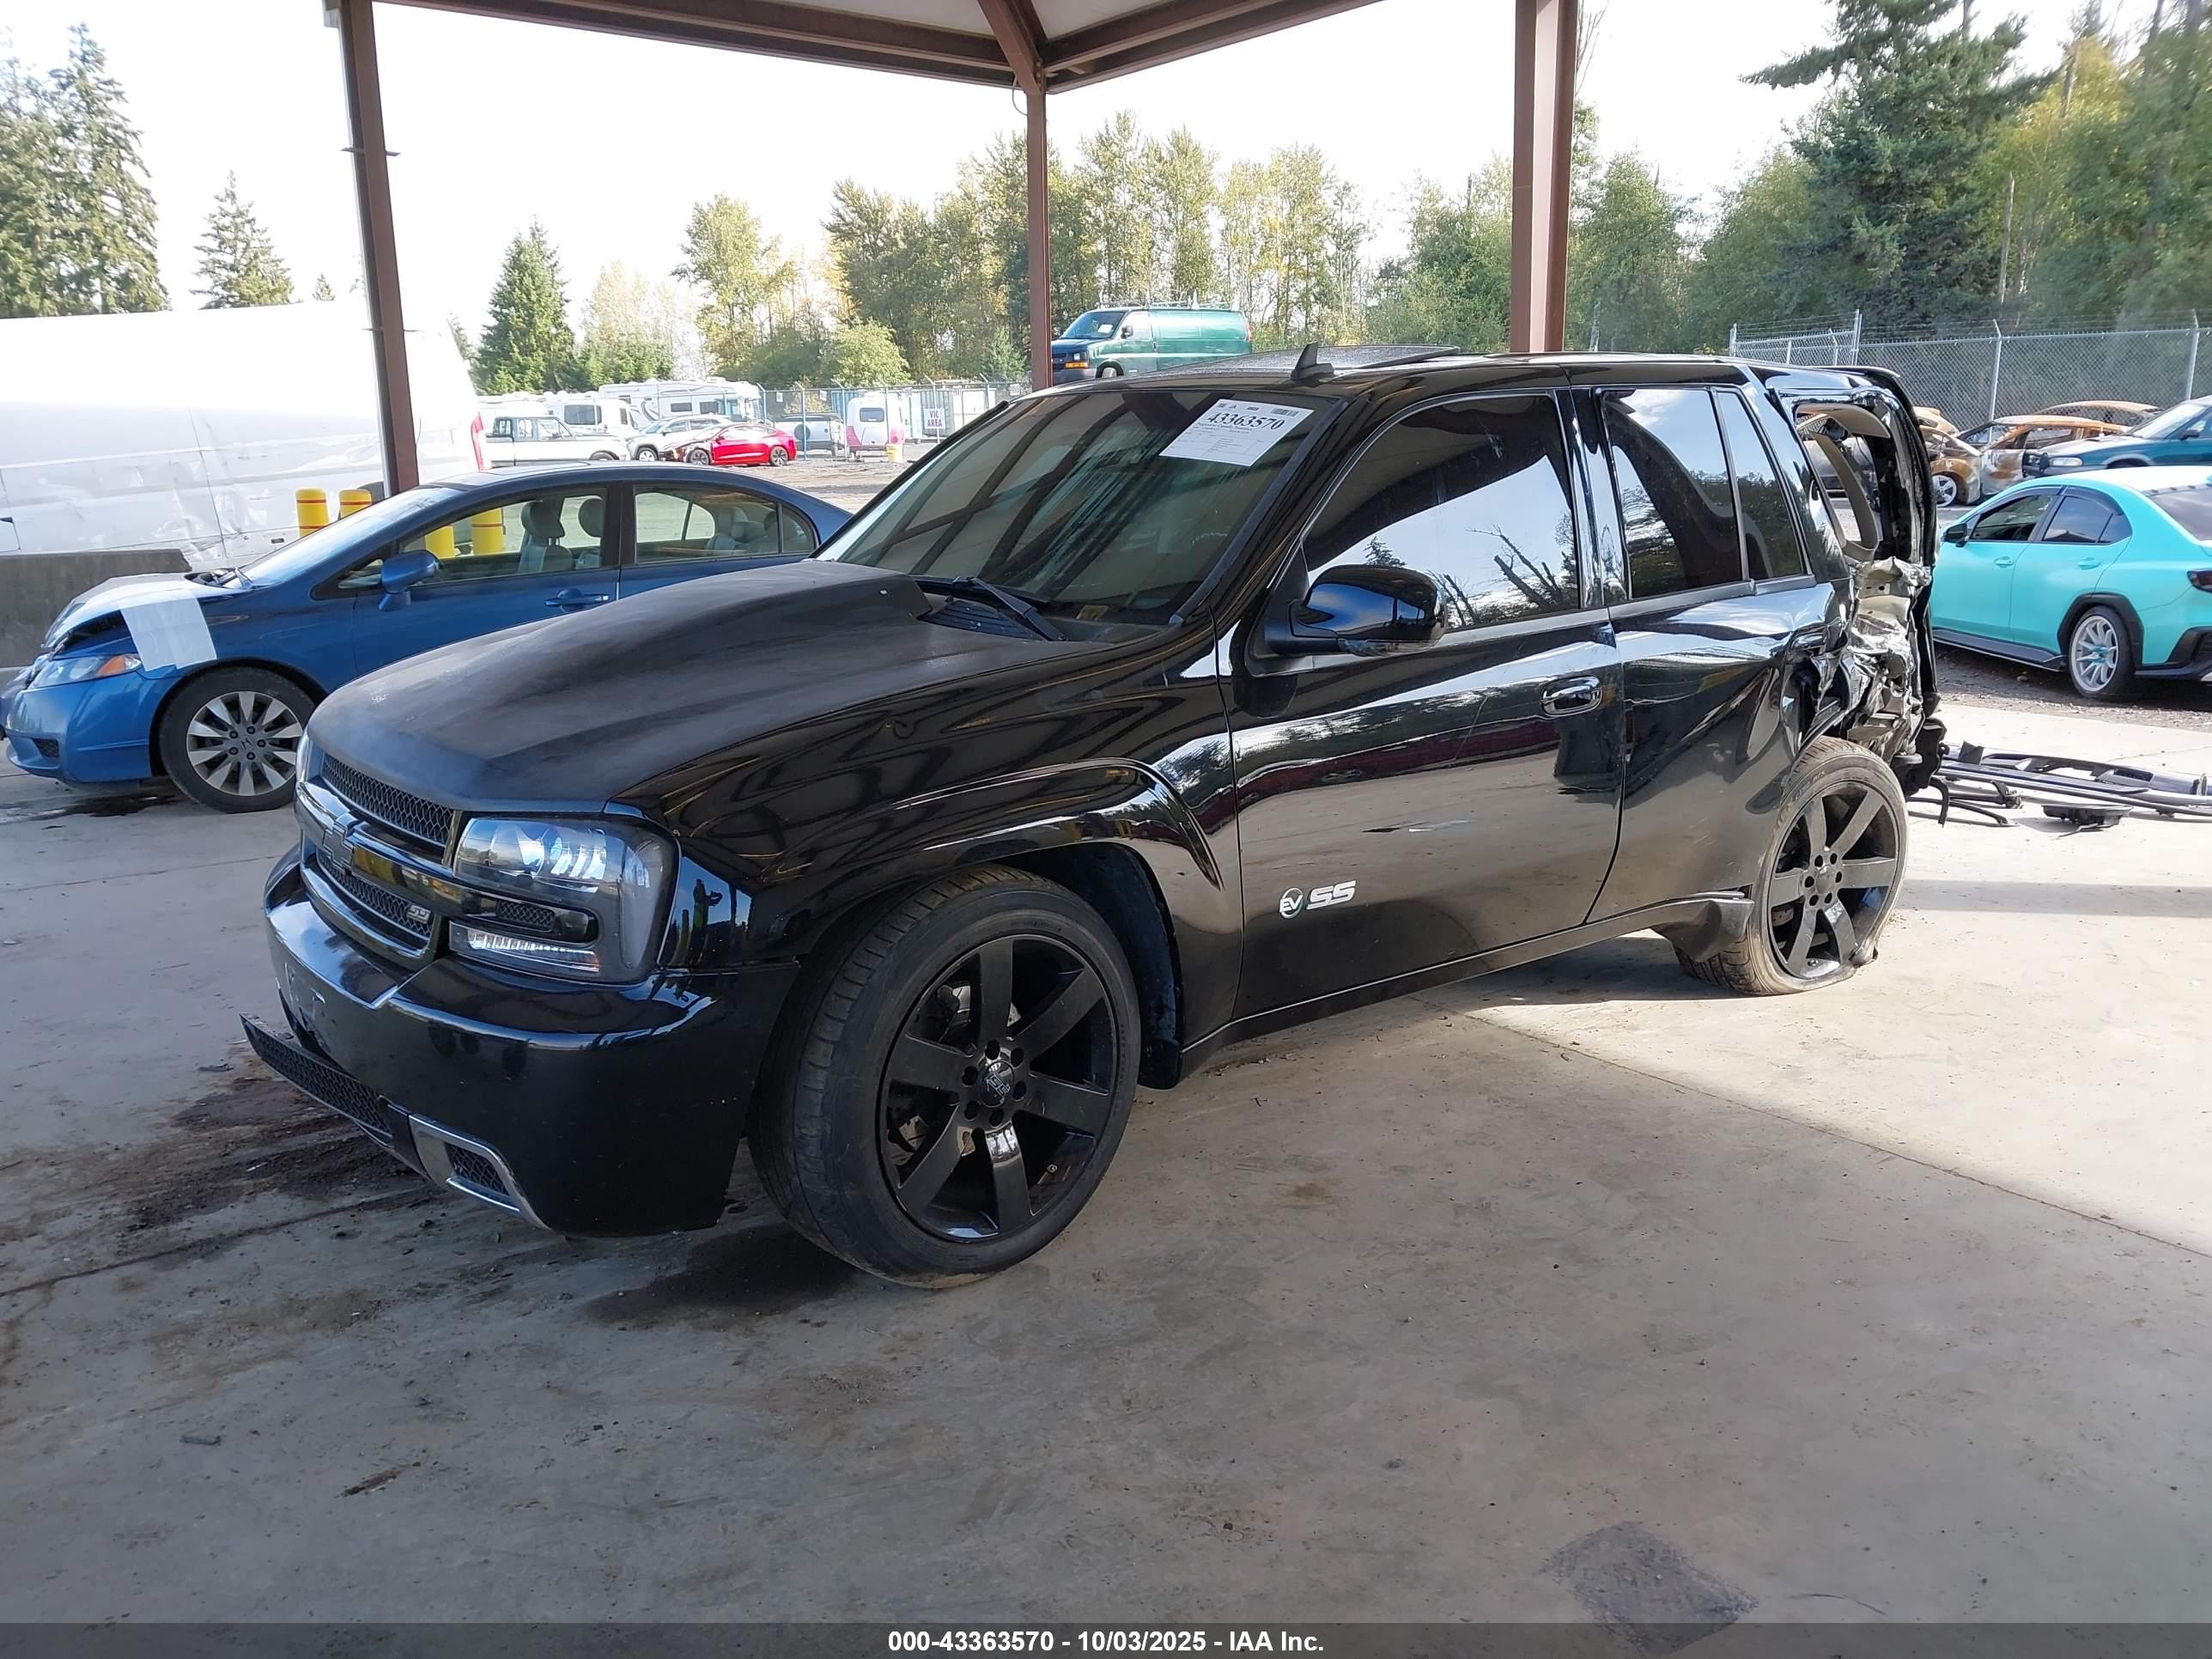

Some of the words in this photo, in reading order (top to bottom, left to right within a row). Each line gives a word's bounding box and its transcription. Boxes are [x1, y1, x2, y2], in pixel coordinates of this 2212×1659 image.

[927, 419, 943, 428] AREA
[1207, 412, 1285, 430] 43363570
[1306, 879, 1357, 910] SS
